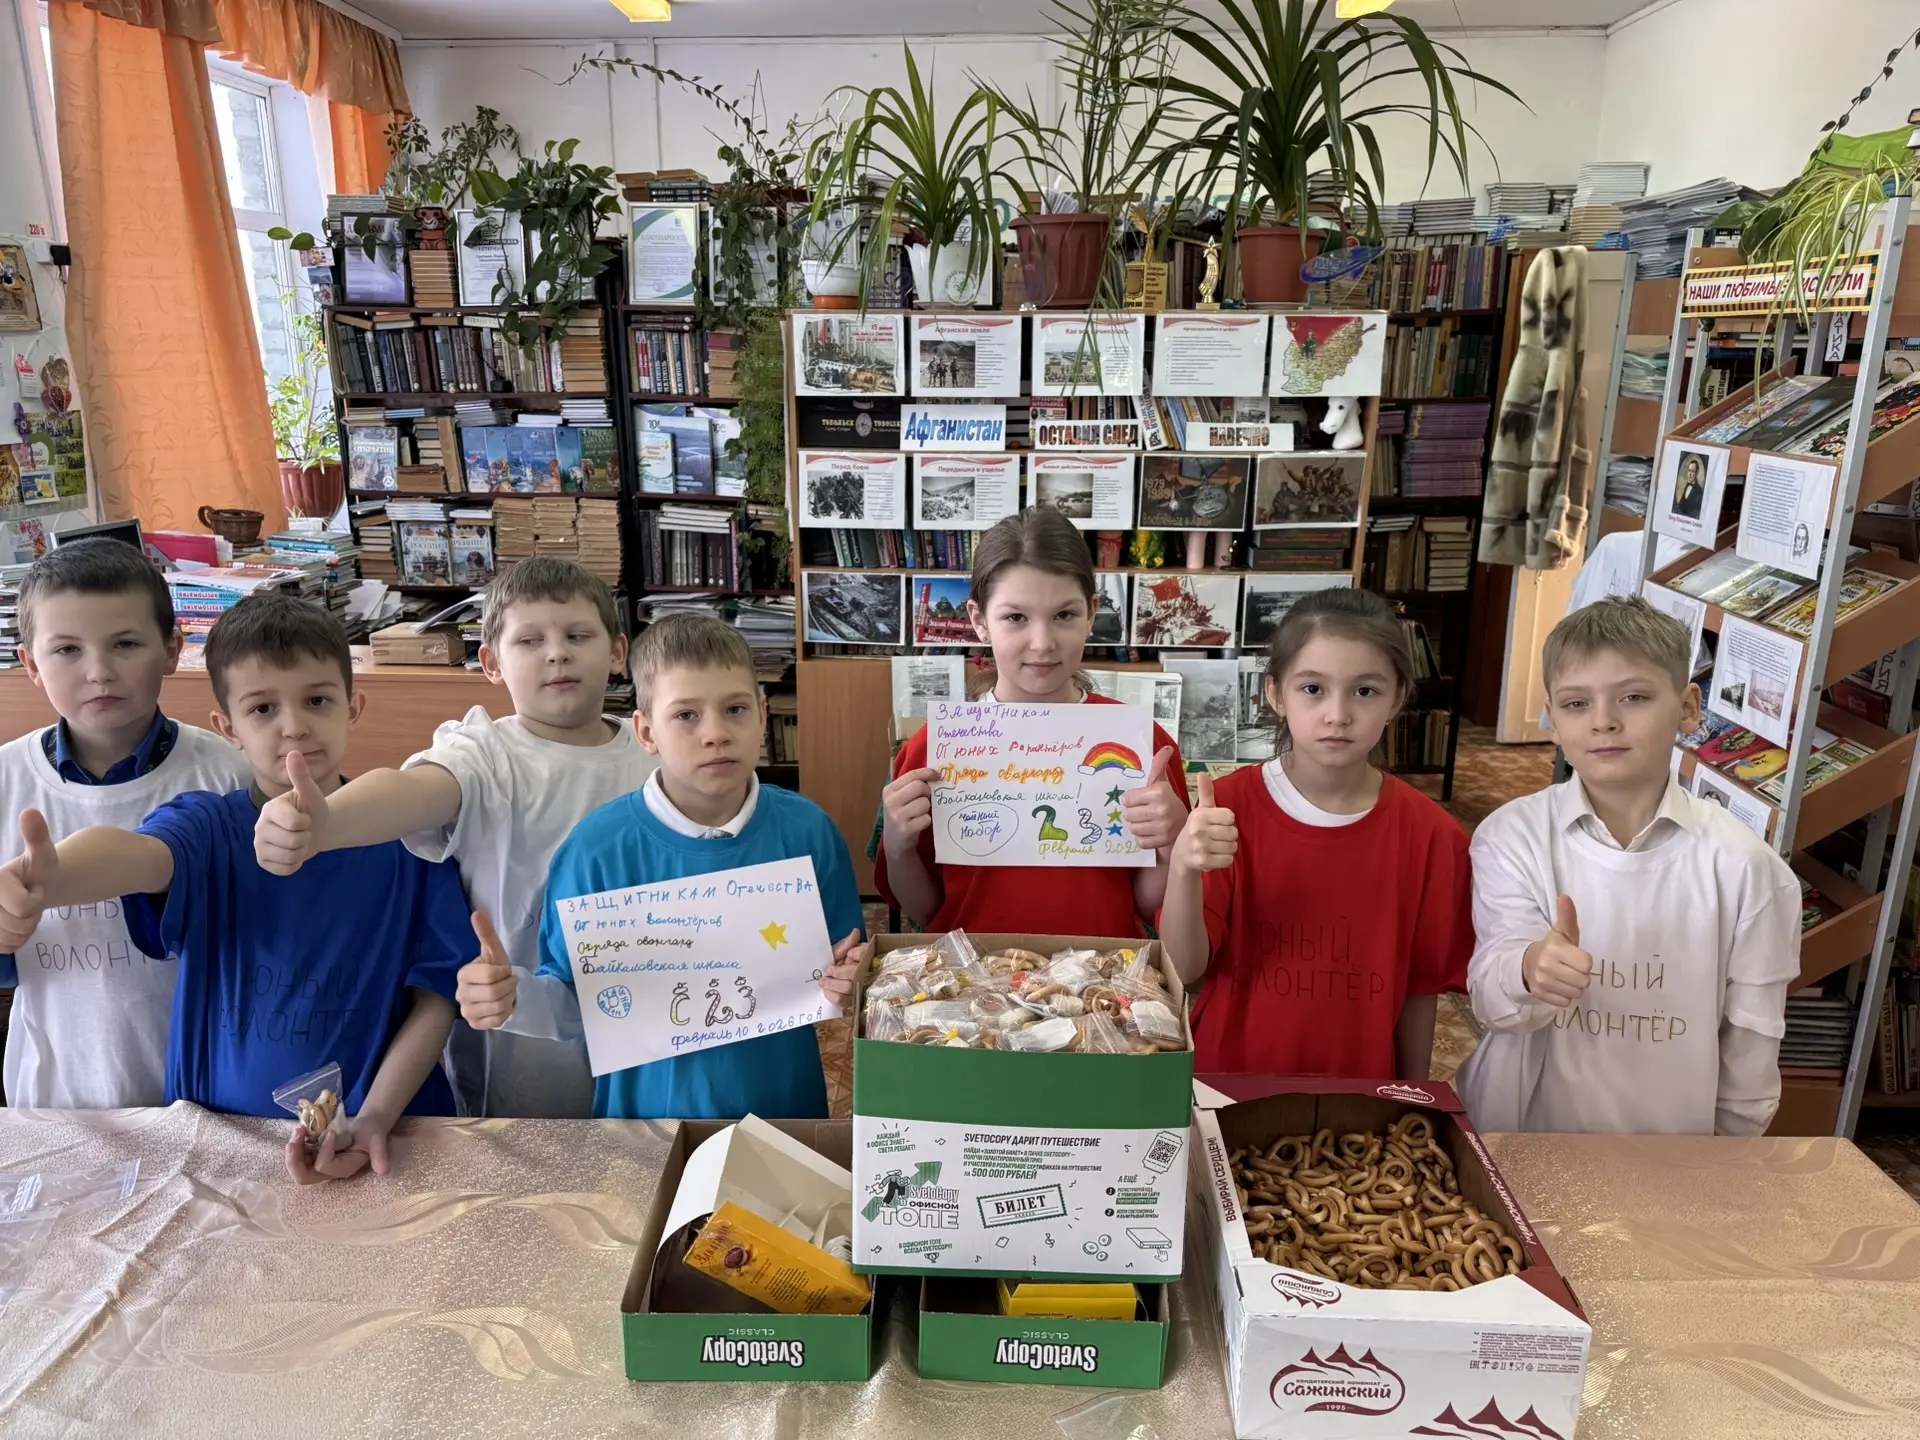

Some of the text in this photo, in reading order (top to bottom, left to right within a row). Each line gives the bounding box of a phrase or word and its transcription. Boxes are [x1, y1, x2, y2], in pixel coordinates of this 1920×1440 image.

[1688, 285, 1720, 300] НАШИ
[934, 326, 967, 335] Афганская
[1065, 327, 1078, 335] Как
[821, 418, 855, 427] ТОБОЛЬСК
[904, 411, 1003, 448] Афганистан
[1039, 424, 1139, 448] ОСТАВИЛ СЛЕД
[1208, 426, 1270, 448] НАВЕЧНО
[831, 463, 851, 471] Перед
[938, 465, 975, 473] Передышка
[981, 466, 1005, 474] ущелье
[954, 745, 1000, 759] юных
[567, 886, 717, 914] ЗАЩИТНИКАМ
[596, 917, 638, 930] юных
[692, 959, 745, 971] школа
[1590, 954, 1666, 992] НЫЙ
[757, 1015, 796, 1035] 2026
[876, 1131, 901, 1140] КАЖДЫЙ
[964, 1132, 1101, 1147] SVETOCOPY ДАРИТ ПУТЕШЕСТВИЕ
[888, 1139, 905, 1147] ЗНАЕТ
[877, 1146, 894, 1154] СВЕТА
[972, 1168, 988, 1178] 500
[988, 1169, 1005, 1178] 000
[1005, 1169, 1038, 1180] РУБЛЕЙ
[1117, 1174, 1138, 1183] А ЕЩЁ
[1207, 1136, 1237, 1223] ВЫБИРАЙ СЕРДЦЕМ!
[909, 1186, 960, 1202] SvetoCopy
[900, 1199, 959, 1210] В ОФИСНОМ
[995, 1195, 1047, 1216] БИЛЕТ
[878, 1206, 959, 1230] ТОПЕ
[902, 1241, 929, 1249] ОФИСНОМ
[728, 1328, 775, 1336] CLASSIC
[1022, 1331, 1070, 1339] CLASSIC
[701, 1335, 805, 1368] SvetoCopy
[994, 1338, 1098, 1372] SvetoCopy
[1283, 1382, 1392, 1399] Сажинский
[1325, 1403, 1346, 1411] 1995
